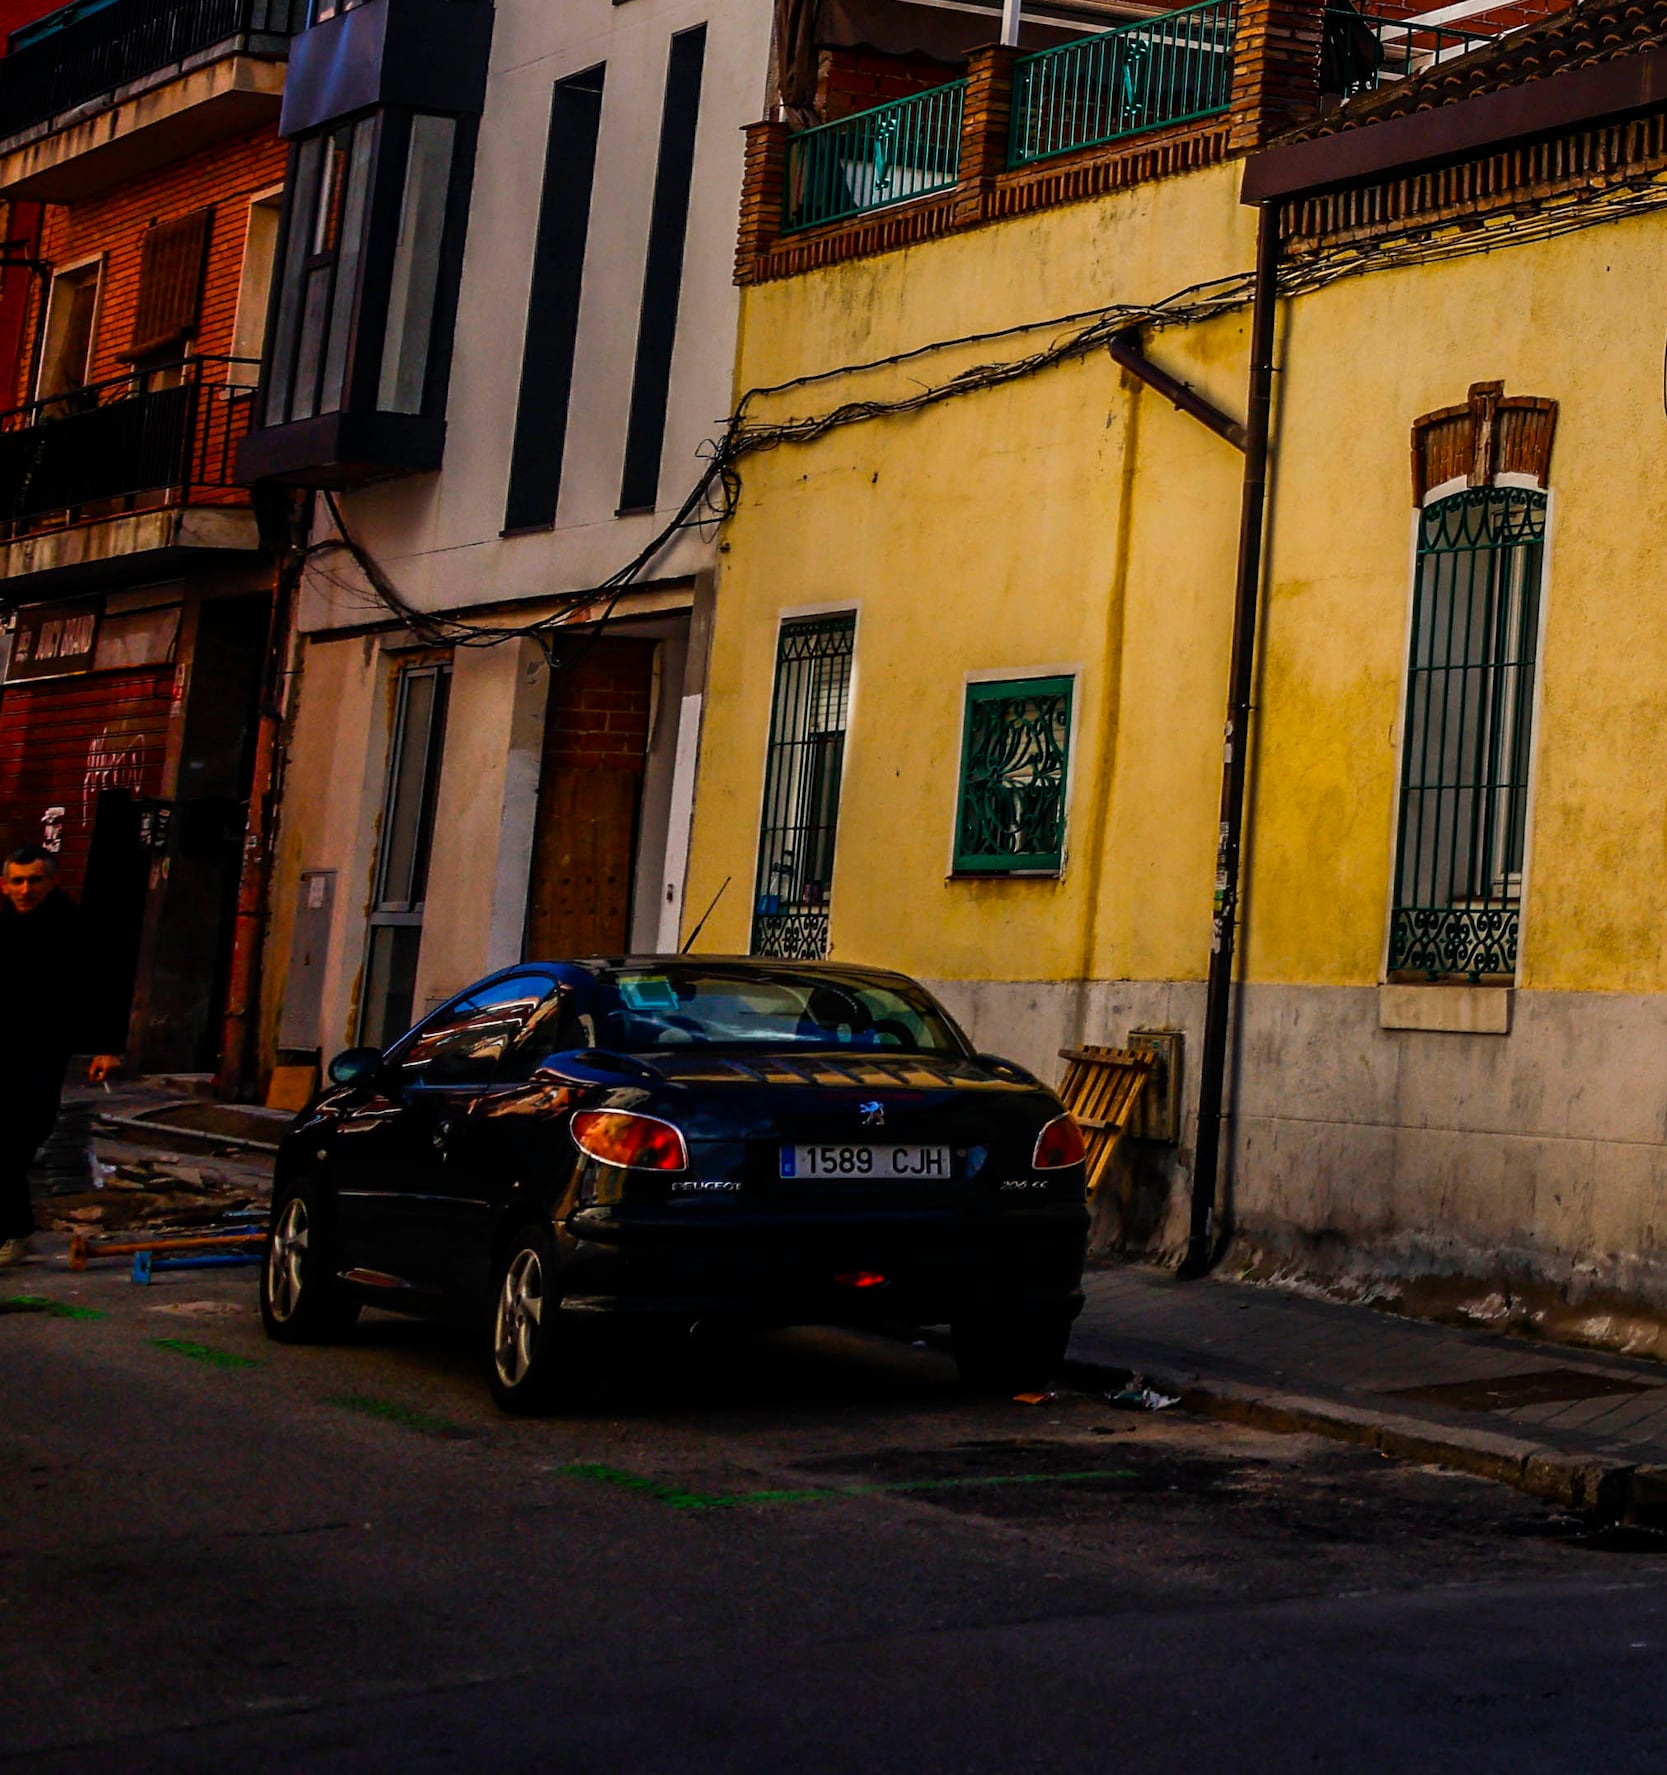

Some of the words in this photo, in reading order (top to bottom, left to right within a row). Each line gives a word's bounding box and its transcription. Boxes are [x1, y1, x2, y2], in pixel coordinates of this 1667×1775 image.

[806, 1147, 873, 1174] 1589
[891, 1148, 943, 1174] CJH
[671, 1181, 745, 1192] PEUGEOT
